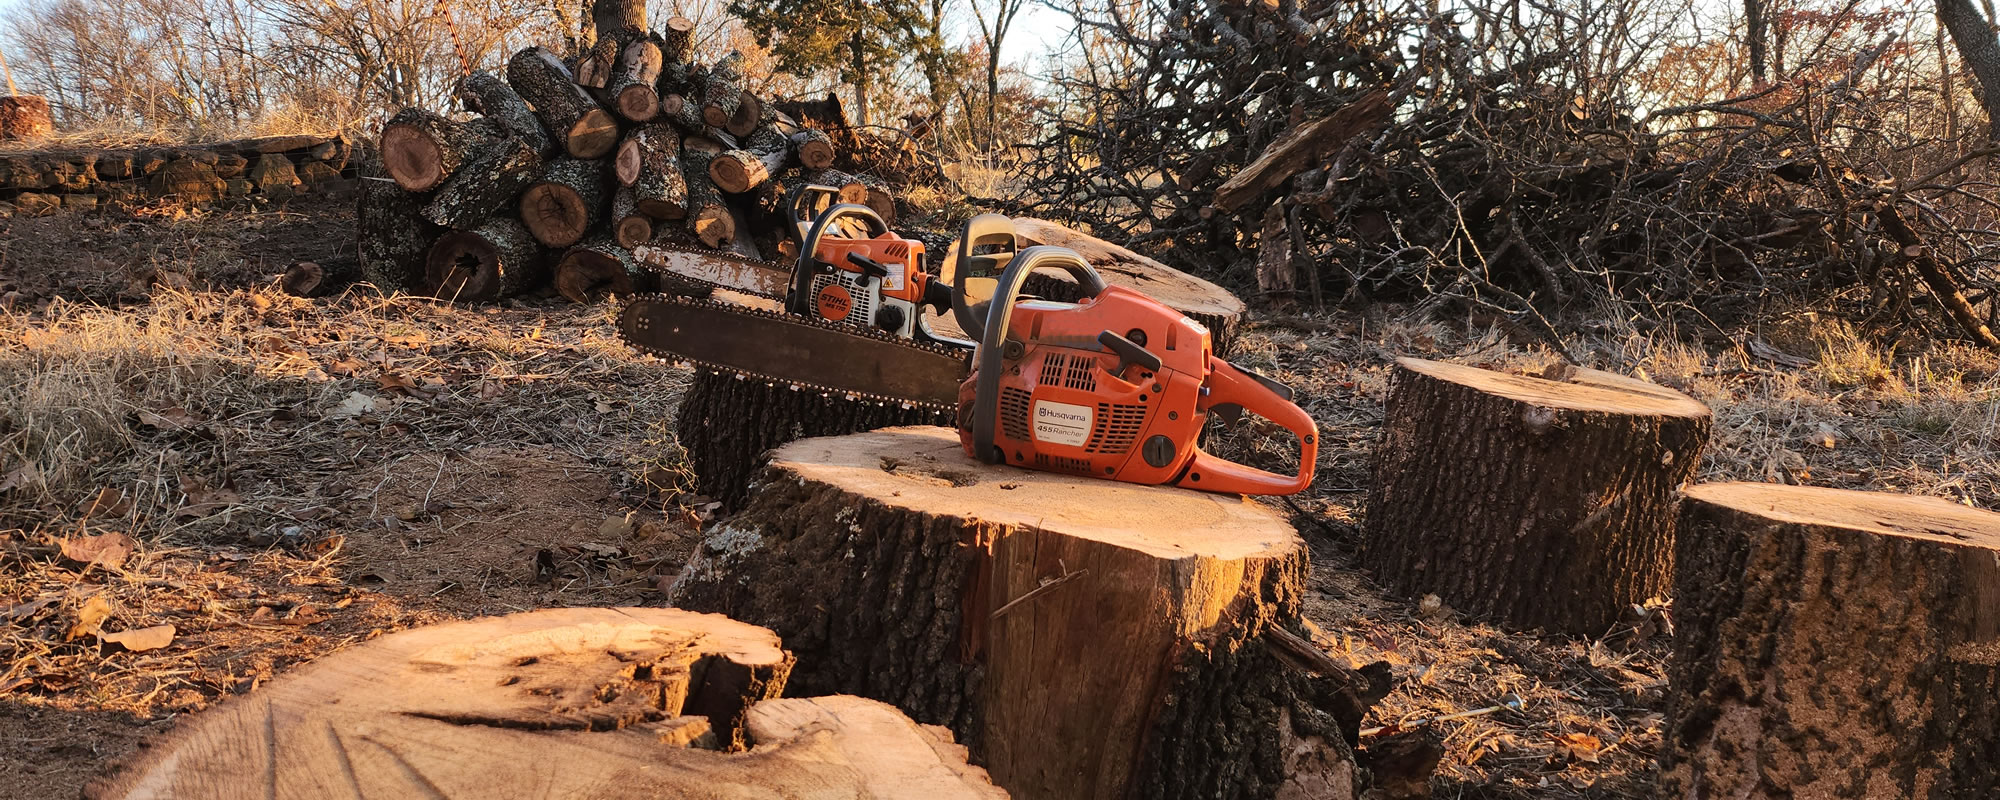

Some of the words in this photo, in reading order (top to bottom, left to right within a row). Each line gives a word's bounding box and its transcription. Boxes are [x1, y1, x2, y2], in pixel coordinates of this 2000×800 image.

[820, 293, 848, 306] STIHL
[1046, 410, 1086, 421] Husqvarna
[1037, 425, 1053, 433] 455
[1053, 427, 1083, 437] Rancher
